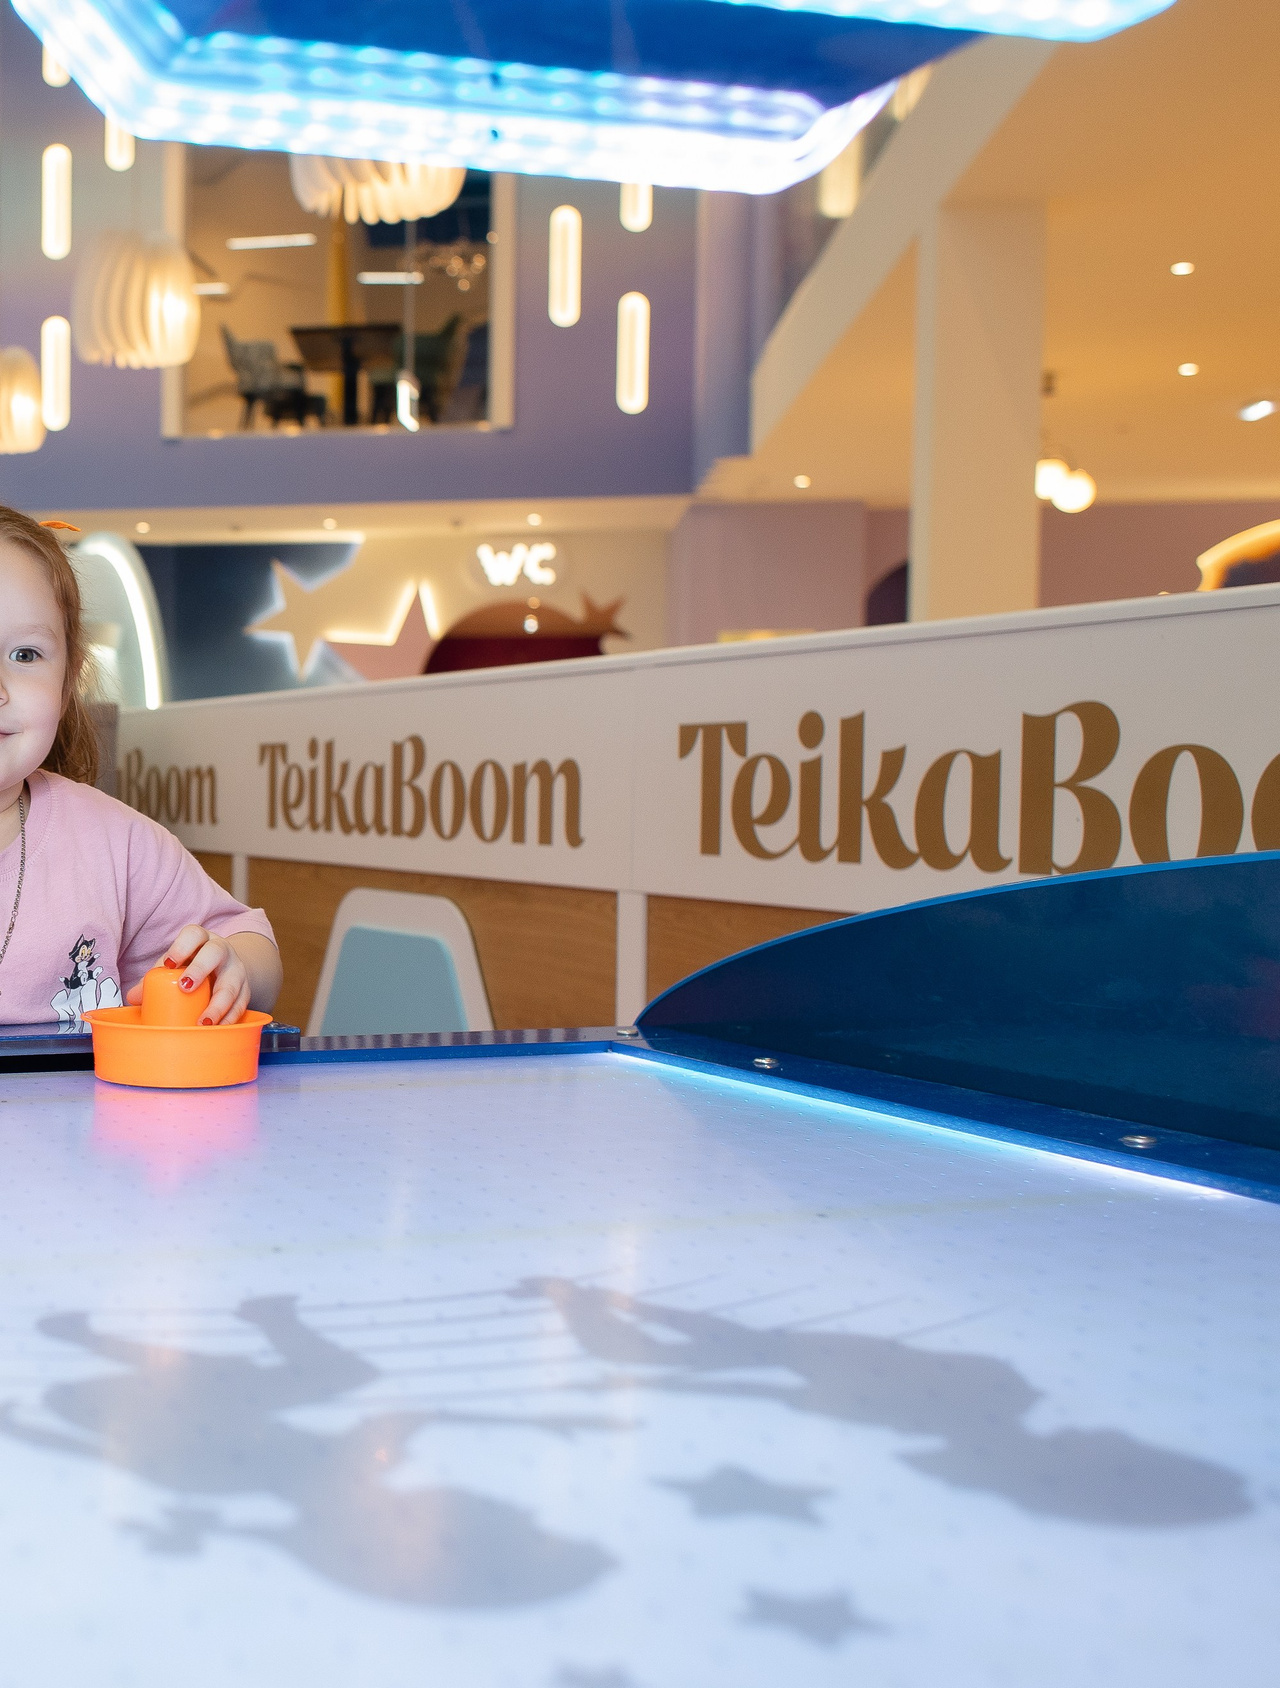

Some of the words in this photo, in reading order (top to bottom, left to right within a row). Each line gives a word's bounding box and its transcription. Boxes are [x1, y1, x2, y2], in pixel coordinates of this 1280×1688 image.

[476, 542, 556, 587] WC
[116, 747, 218, 825] Boom
[259, 735, 584, 848] TeikaBoom
[679, 700, 1280, 875] TeikaBo
